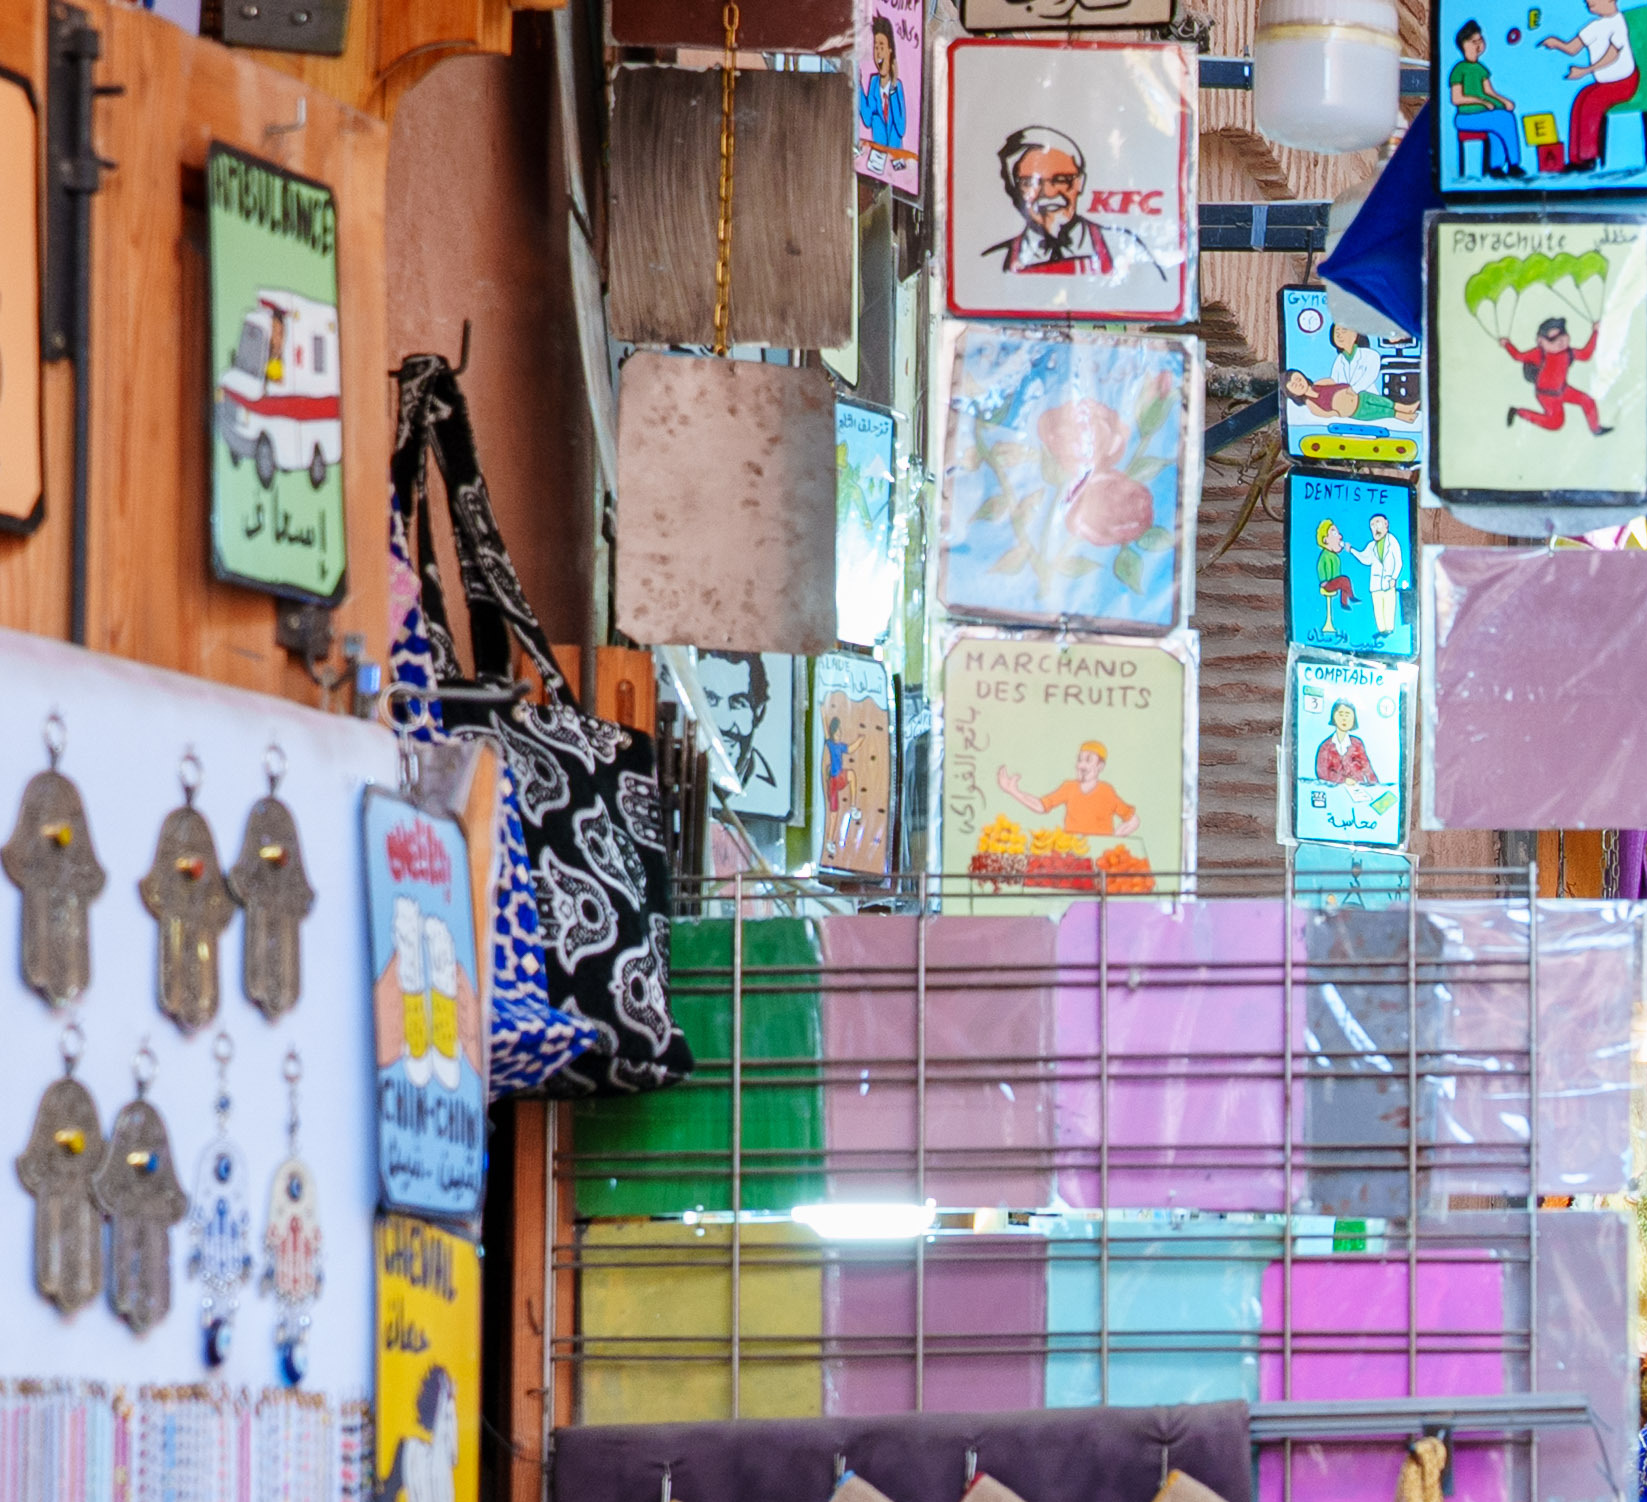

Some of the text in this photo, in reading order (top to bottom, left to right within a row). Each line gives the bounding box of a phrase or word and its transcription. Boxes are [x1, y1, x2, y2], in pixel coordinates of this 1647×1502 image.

[1086, 189, 1165, 216] KFC
[1453, 229, 1568, 255] Parachute
[965, 651, 1138, 678] MARCHAND
[976, 679, 1153, 710] DES FRUITS
